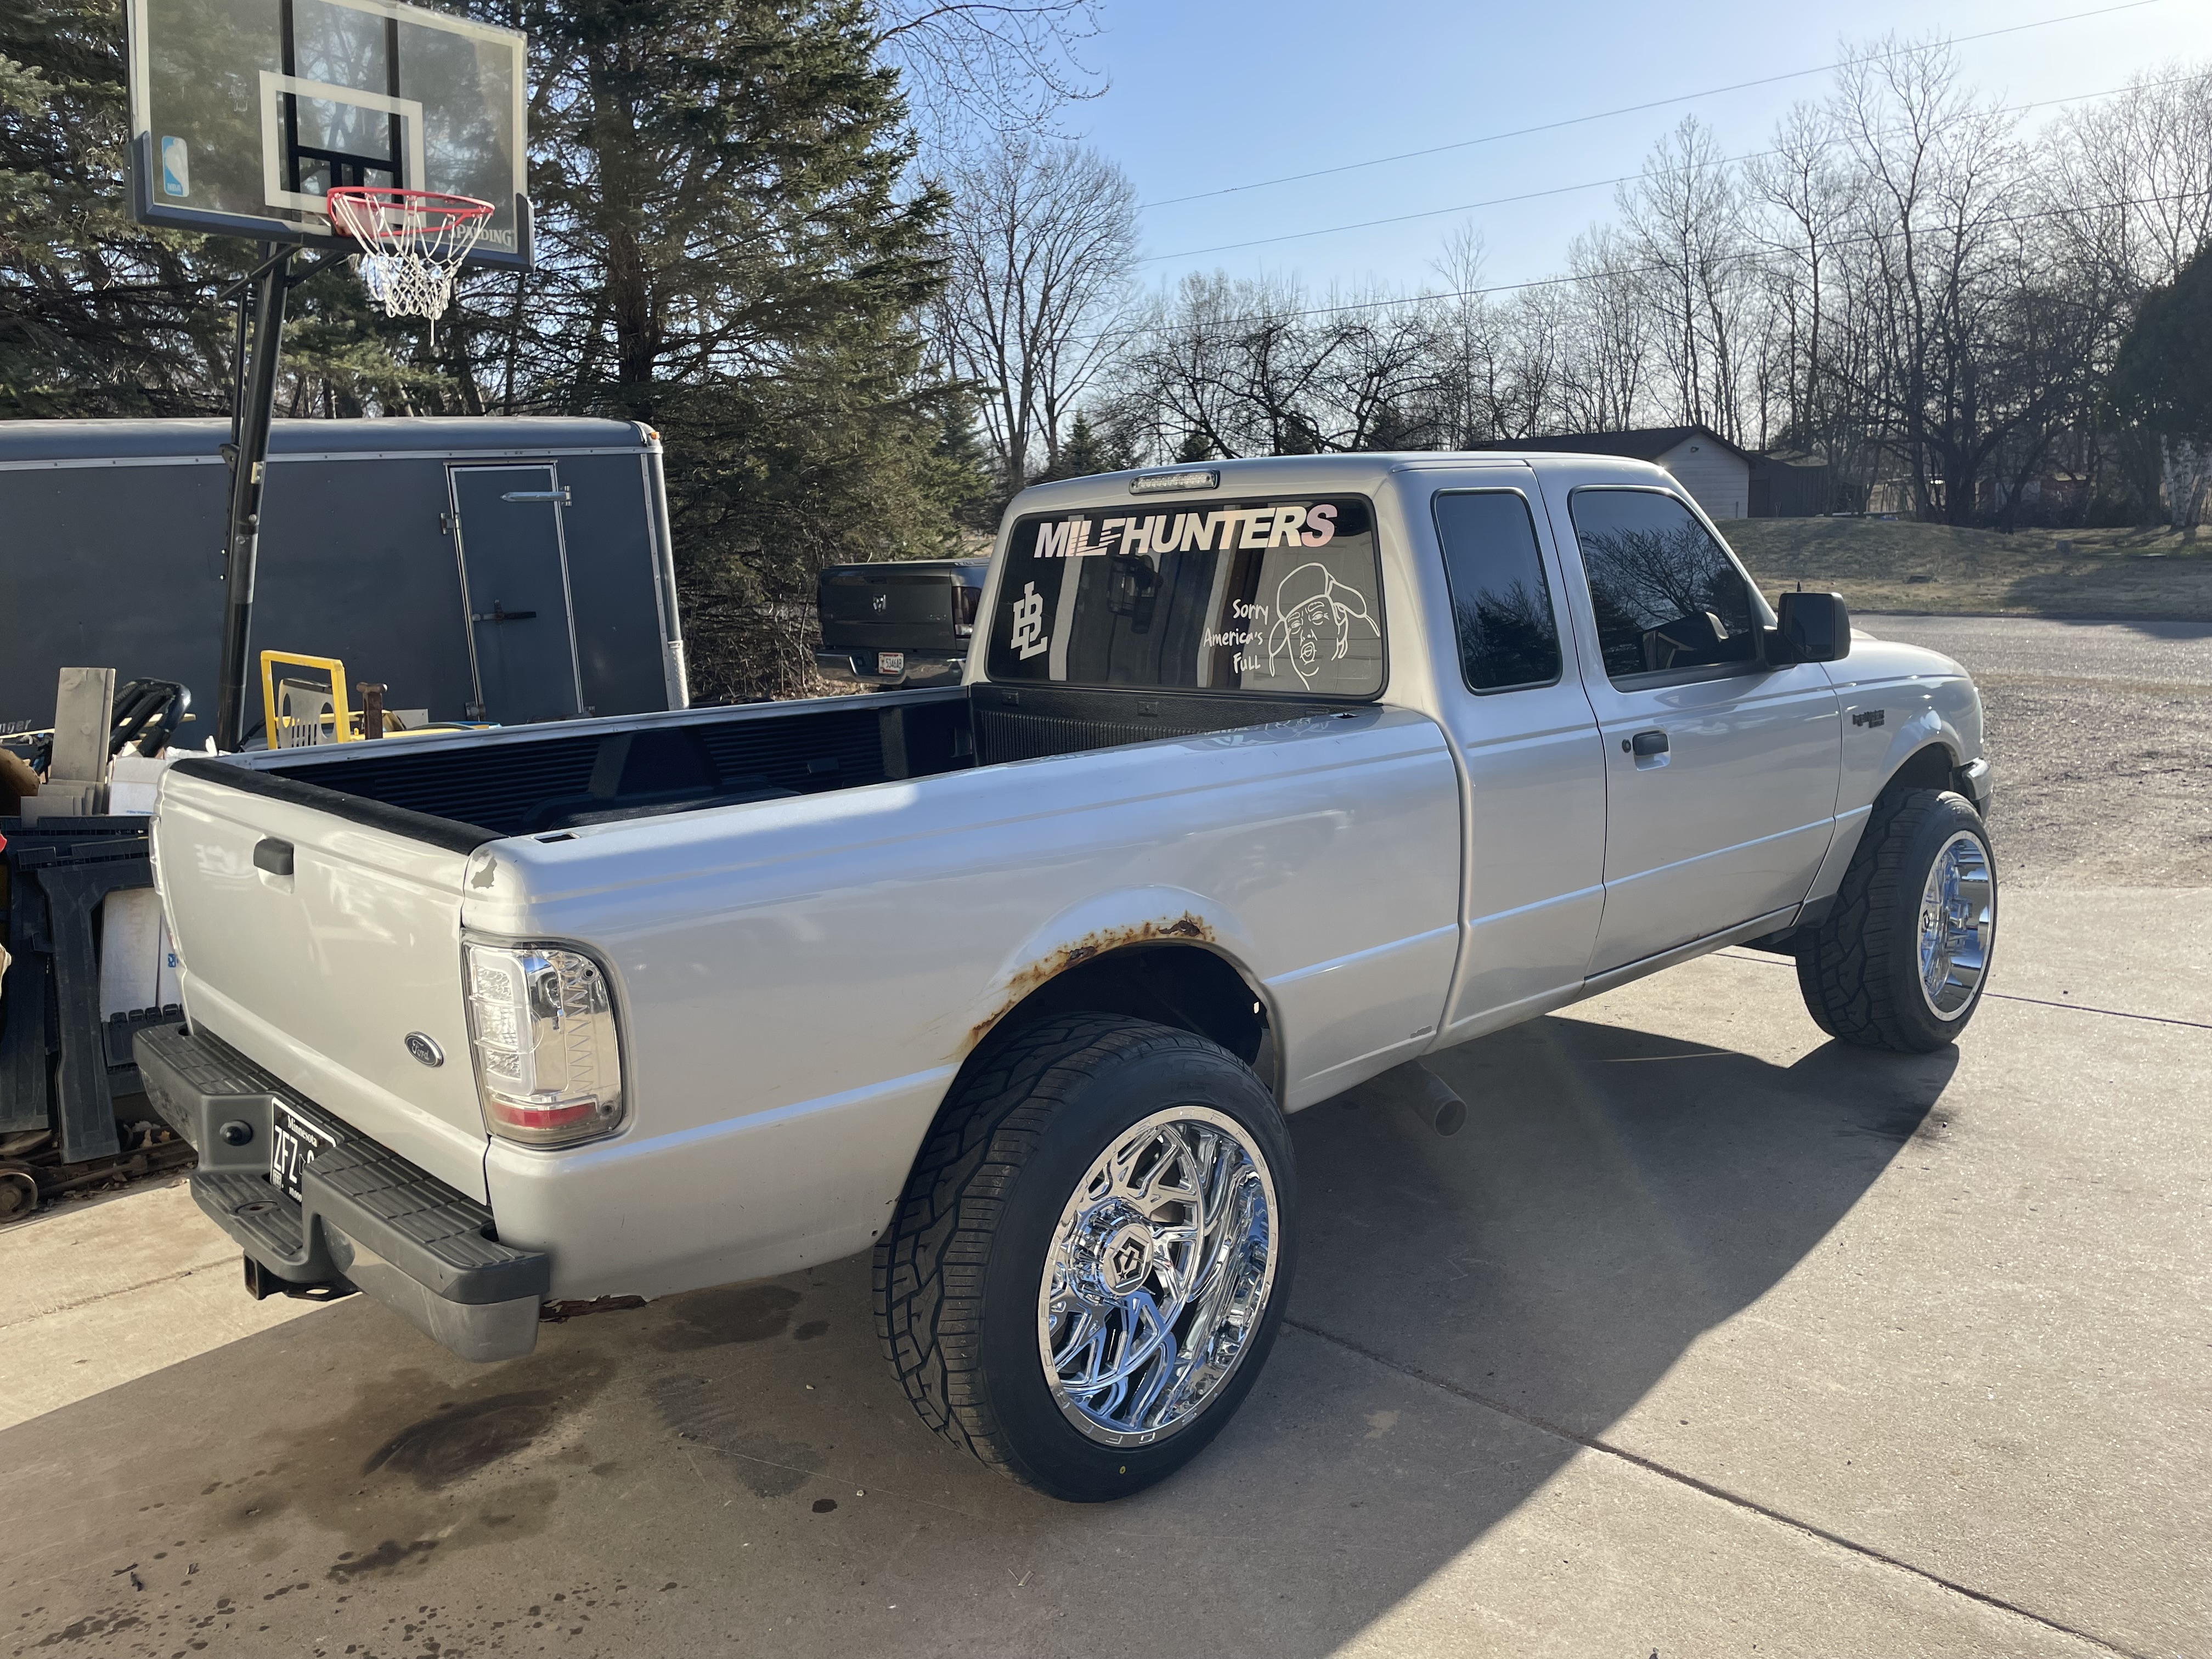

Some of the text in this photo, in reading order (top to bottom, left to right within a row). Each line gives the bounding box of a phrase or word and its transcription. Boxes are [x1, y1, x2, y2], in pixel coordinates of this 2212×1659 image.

[1232, 599, 1269, 625] Sorry
[1203, 627, 1263, 647] America's
[287, 1115, 318, 1148] Minnesota
